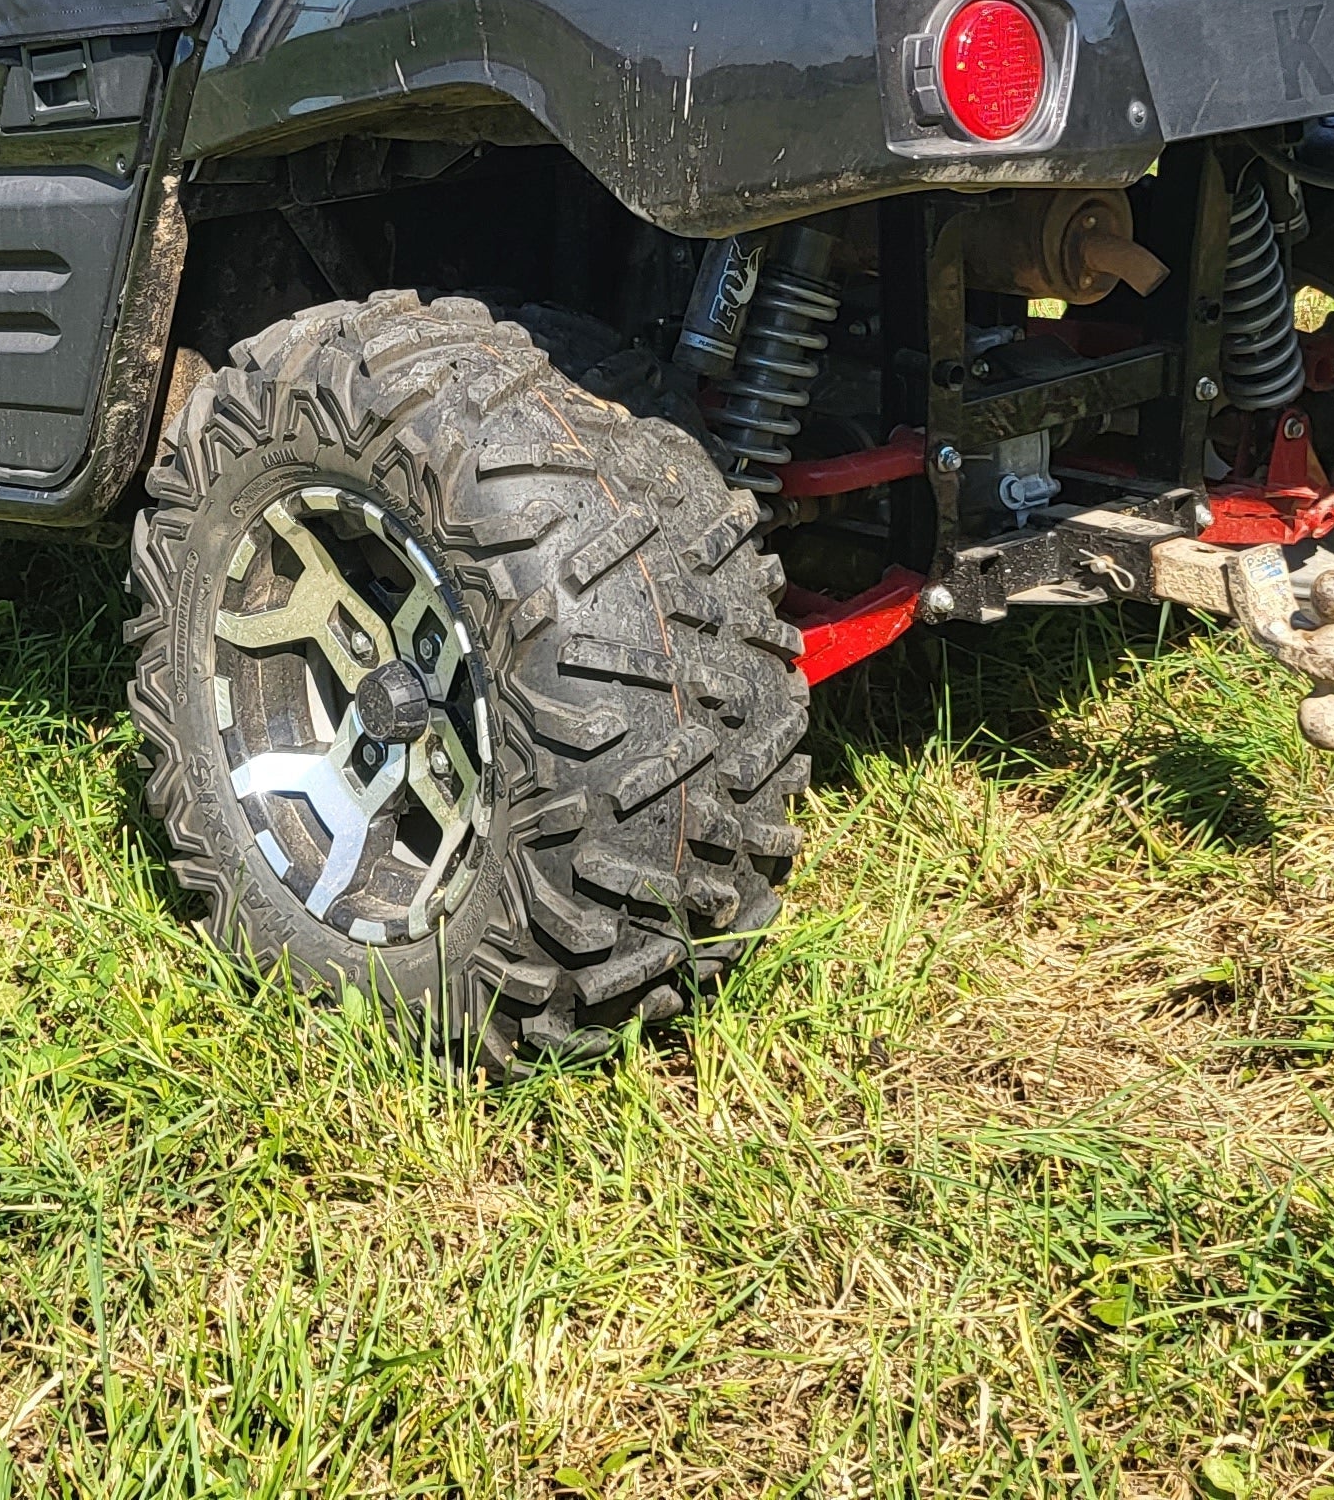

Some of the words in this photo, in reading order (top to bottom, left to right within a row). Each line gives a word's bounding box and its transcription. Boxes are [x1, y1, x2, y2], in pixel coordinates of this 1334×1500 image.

[709, 236, 763, 334] FOX
[261, 447, 300, 469] RADIAL
[188, 755, 297, 944] MAXXIS
